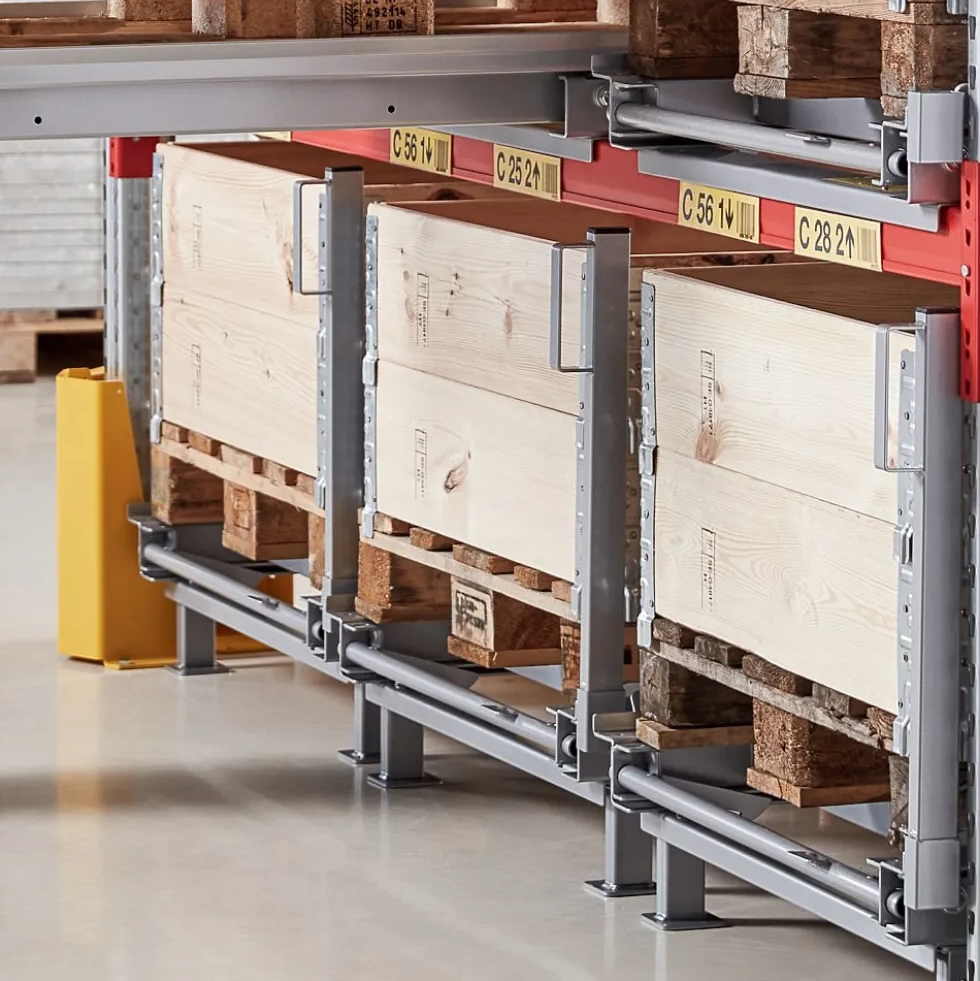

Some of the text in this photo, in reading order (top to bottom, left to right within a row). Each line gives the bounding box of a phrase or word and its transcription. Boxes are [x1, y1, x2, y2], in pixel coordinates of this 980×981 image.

[393, 129, 425, 164] C 56 1
[496, 151, 532, 188] C 25 2
[682, 188, 724, 229] C 56 1
[799, 215, 845, 256] C 28 2
